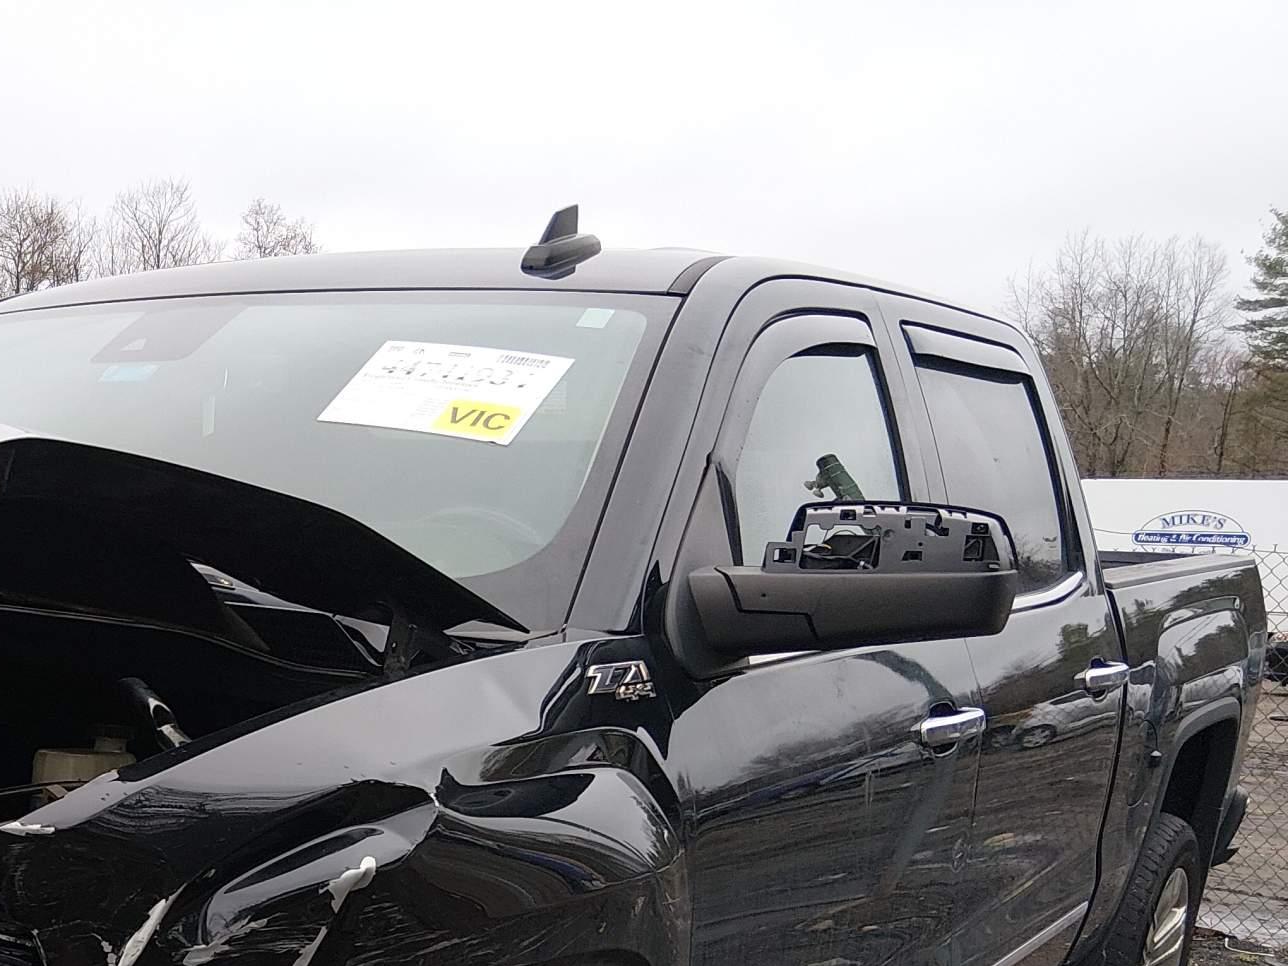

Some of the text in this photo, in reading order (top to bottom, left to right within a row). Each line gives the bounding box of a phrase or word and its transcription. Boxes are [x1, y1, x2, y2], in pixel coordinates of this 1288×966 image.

[449, 406, 511, 431] VIC
[1160, 513, 1227, 529] MIKE'S
[1137, 532, 1169, 544] Heating
[1192, 533, 1247, 546] Conditioning
